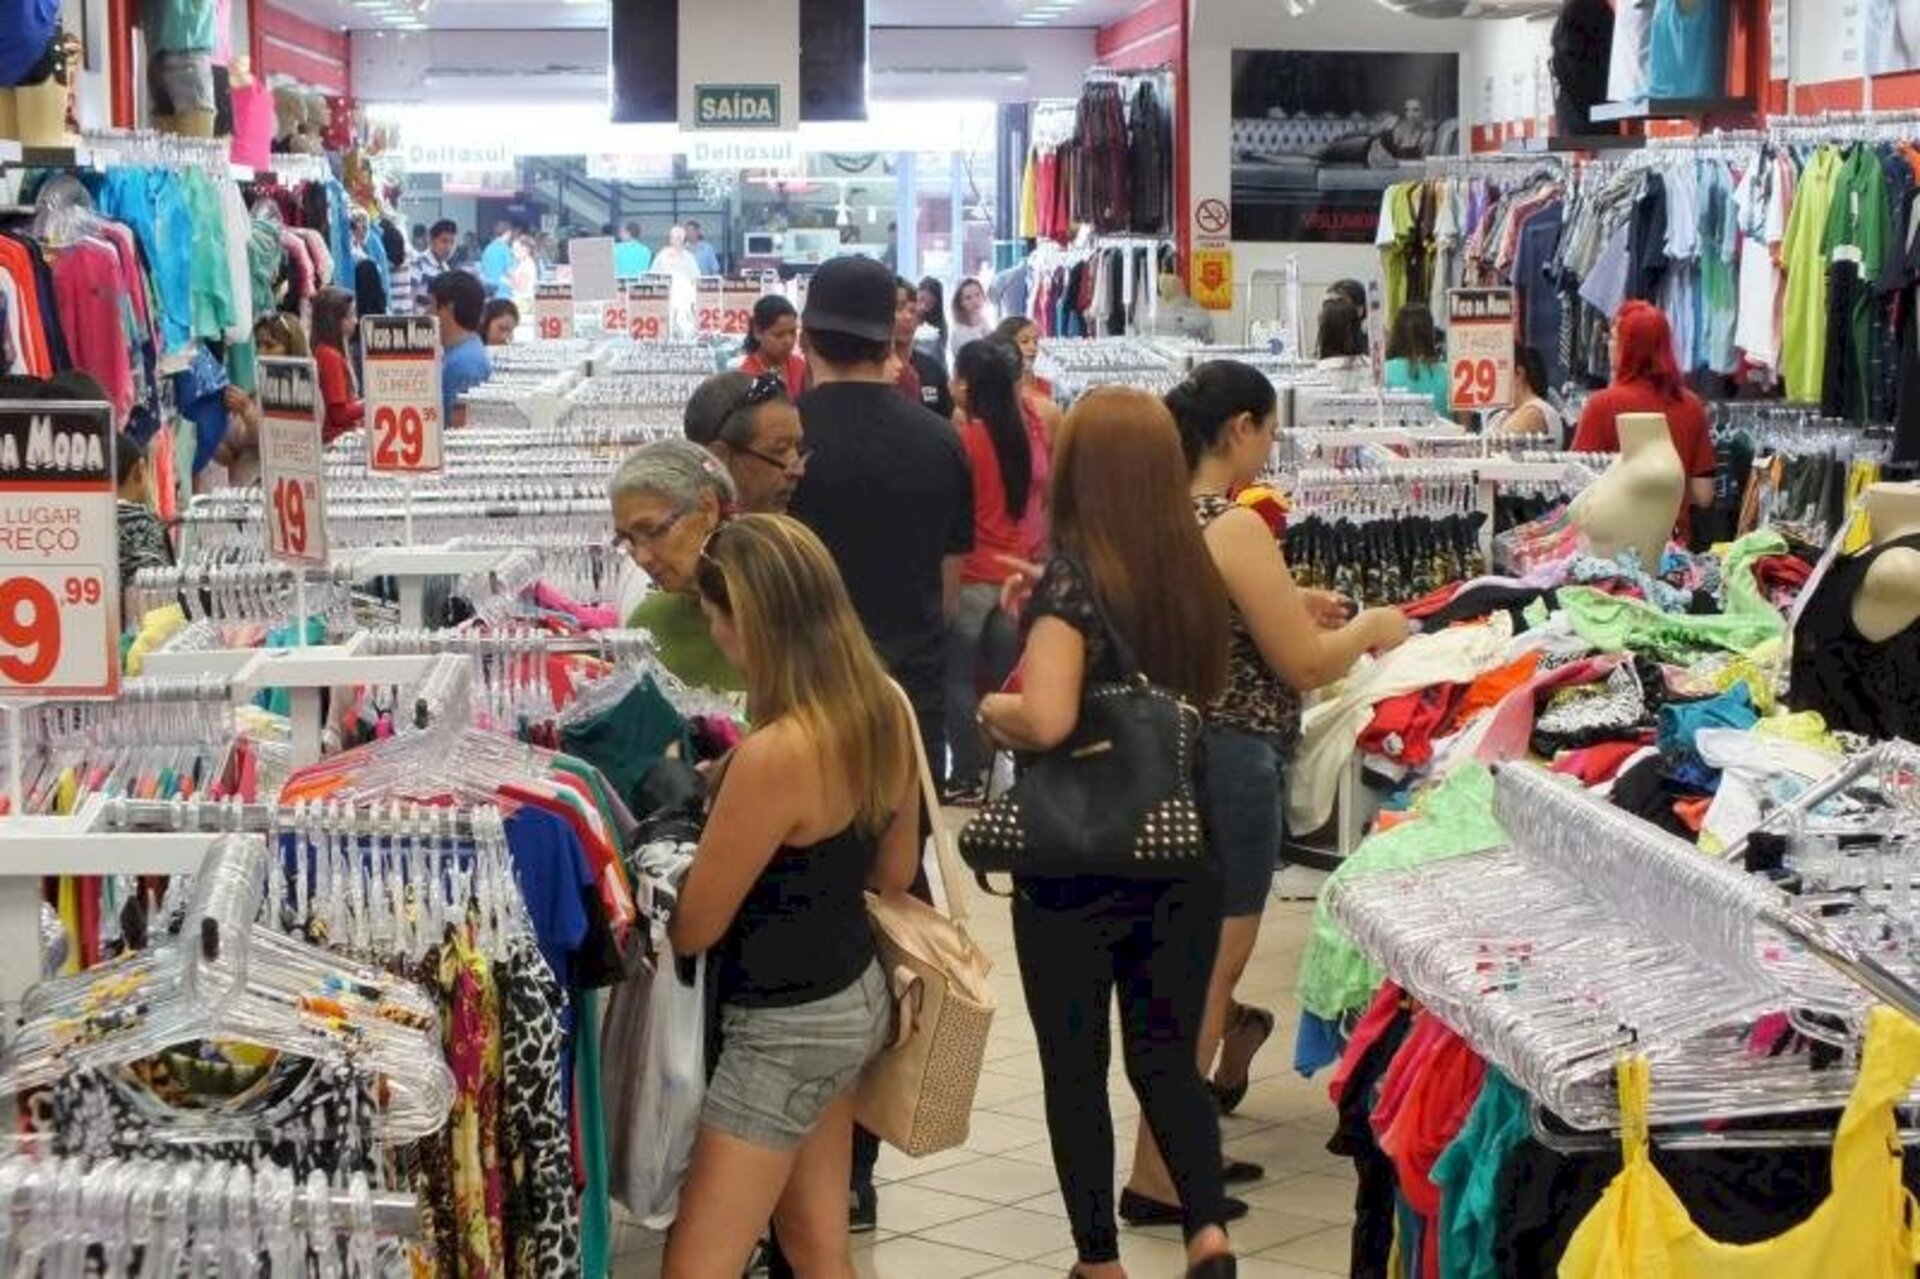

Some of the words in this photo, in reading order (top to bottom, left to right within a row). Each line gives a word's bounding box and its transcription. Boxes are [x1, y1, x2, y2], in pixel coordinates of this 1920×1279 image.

[702, 92, 773, 120] SAÍDA
[695, 142, 792, 161] Deltasul
[539, 316, 562, 339] 19
[632, 316, 659, 340] 29
[1453, 359, 1496, 403] 29
[26, 414, 104, 471] MODA
[374, 406, 423, 465] 29
[5, 507, 80, 524] LUGAR
[273, 476, 307, 553] 19
[0, 527, 80, 557] REÇO
[0, 576, 60, 685] 9
